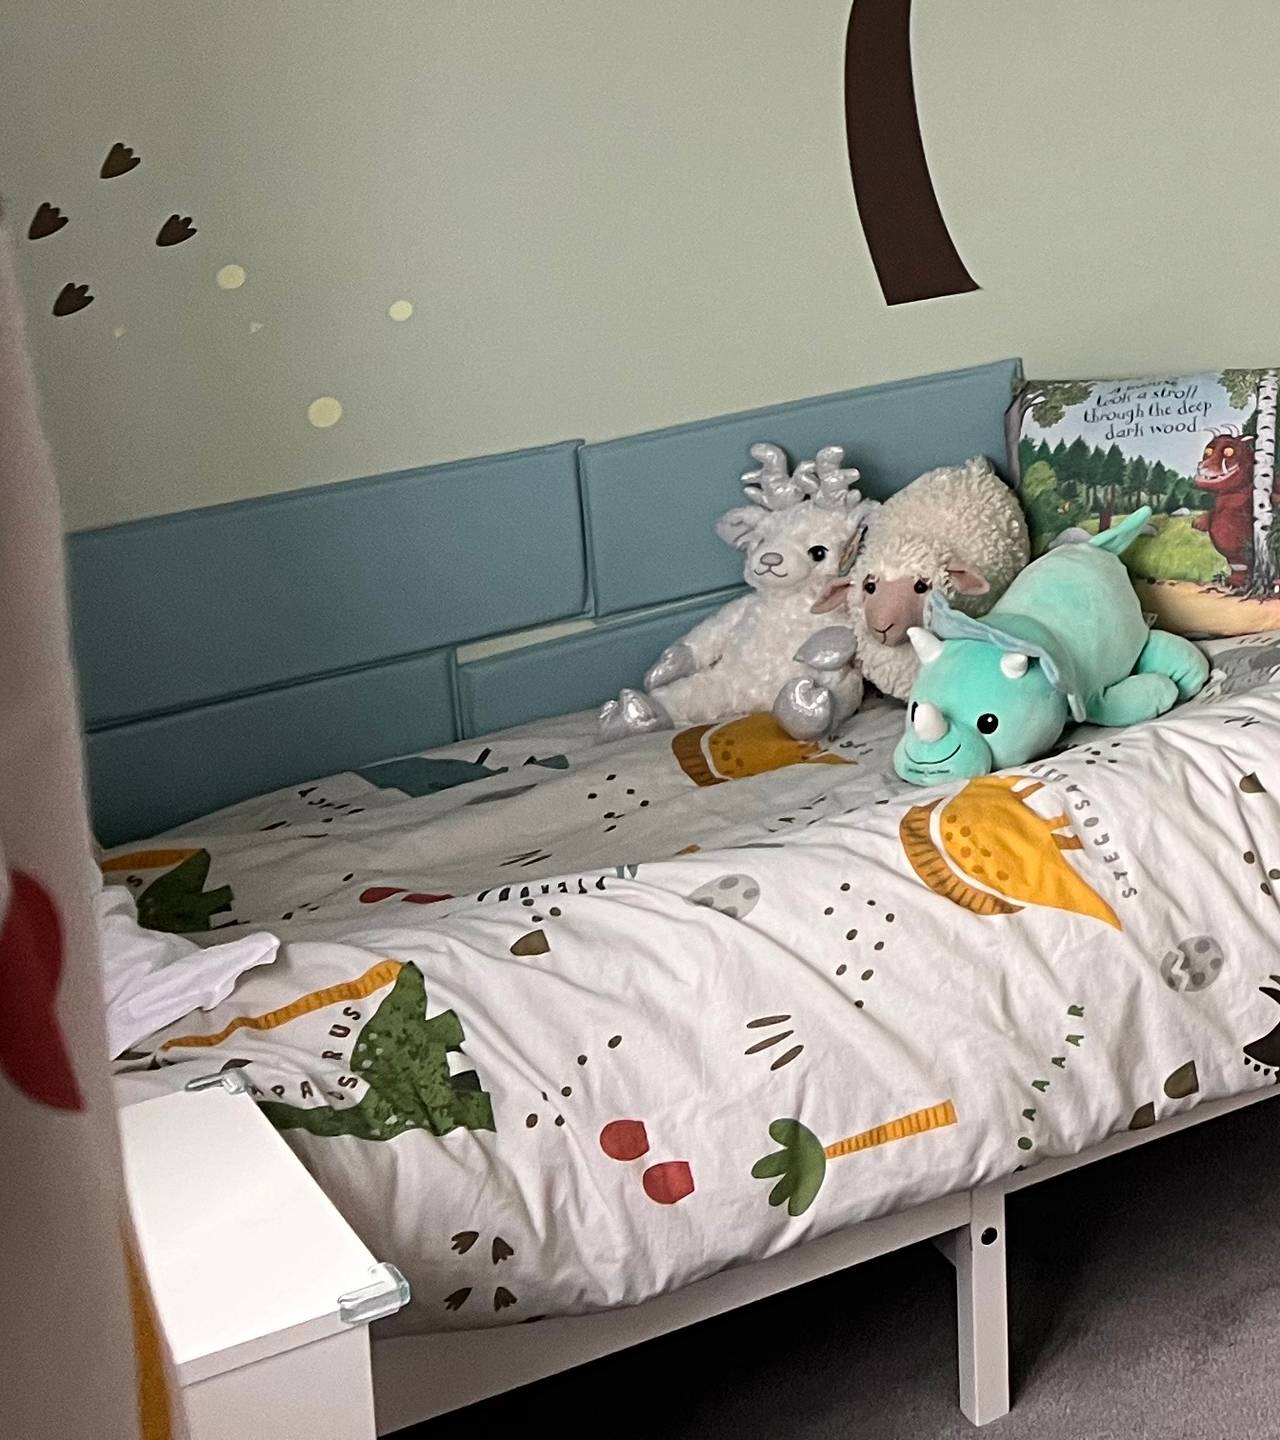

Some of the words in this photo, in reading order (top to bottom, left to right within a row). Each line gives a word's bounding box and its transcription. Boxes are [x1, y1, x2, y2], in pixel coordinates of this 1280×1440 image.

[1153, 384, 1198, 400] stroll
[1084, 402, 1144, 425] through
[1149, 401, 1171, 417] the
[1177, 400, 1212, 417] deep
[1105, 423, 1144, 441] dark
[1150, 416, 1197, 435] wood
